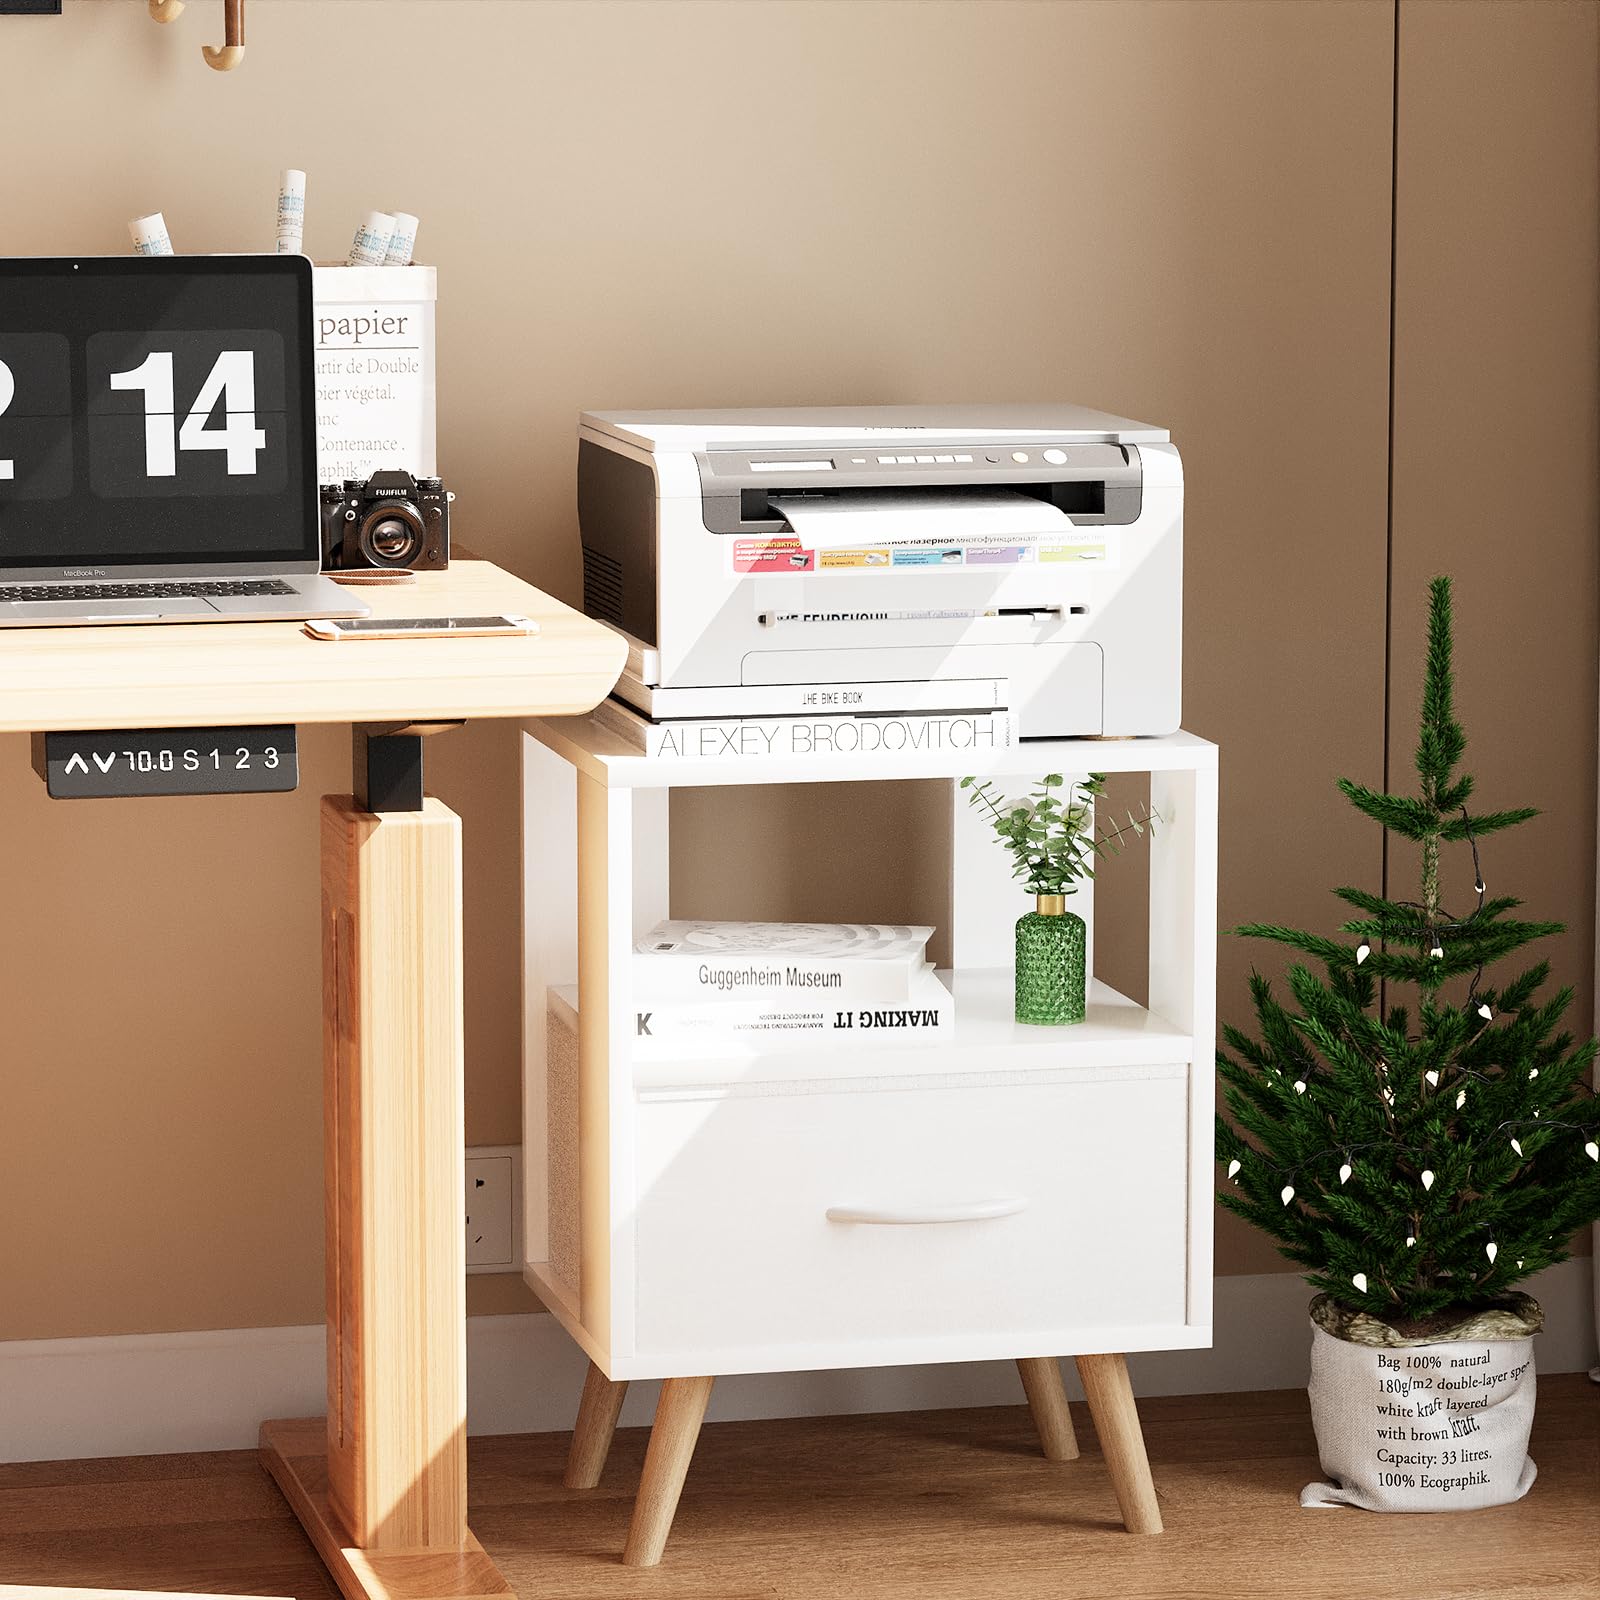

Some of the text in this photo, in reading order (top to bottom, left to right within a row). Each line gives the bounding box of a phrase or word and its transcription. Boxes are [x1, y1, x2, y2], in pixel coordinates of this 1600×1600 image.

[318, 309, 408, 344] papier
[346, 358, 363, 374] de
[367, 357, 419, 373] Double
[345, 384, 396, 405] végétal.
[110, 350, 266, 477] 14
[63, 569, 106, 578] MacBook Pro
[803, 691, 863, 705] THE BIKE BOOK
[658, 725, 780, 757] ALEXEY
[792, 719, 994, 753] BRODOVITCH
[209, 748, 220, 769] 1
[235, 747, 250, 769] 2
[264, 746, 279, 769] 3
[698, 965, 842, 990] Guggenheim Museum
[833, 1010, 939, 1029] MAKING IT
[1377, 1350, 1490, 1371] Bag 100% natural
[1379, 1377, 1433, 1397] 180g/m2
[1437, 1371, 1508, 1391] double-layer
[1377, 1395, 1488, 1418] white kraft layered
[1377, 1415, 1480, 1441] with brown kraft.
[1377, 1449, 1492, 1469] Capacity: 33 litres.
[1379, 1471, 1491, 1491] 100% Ecographik.
